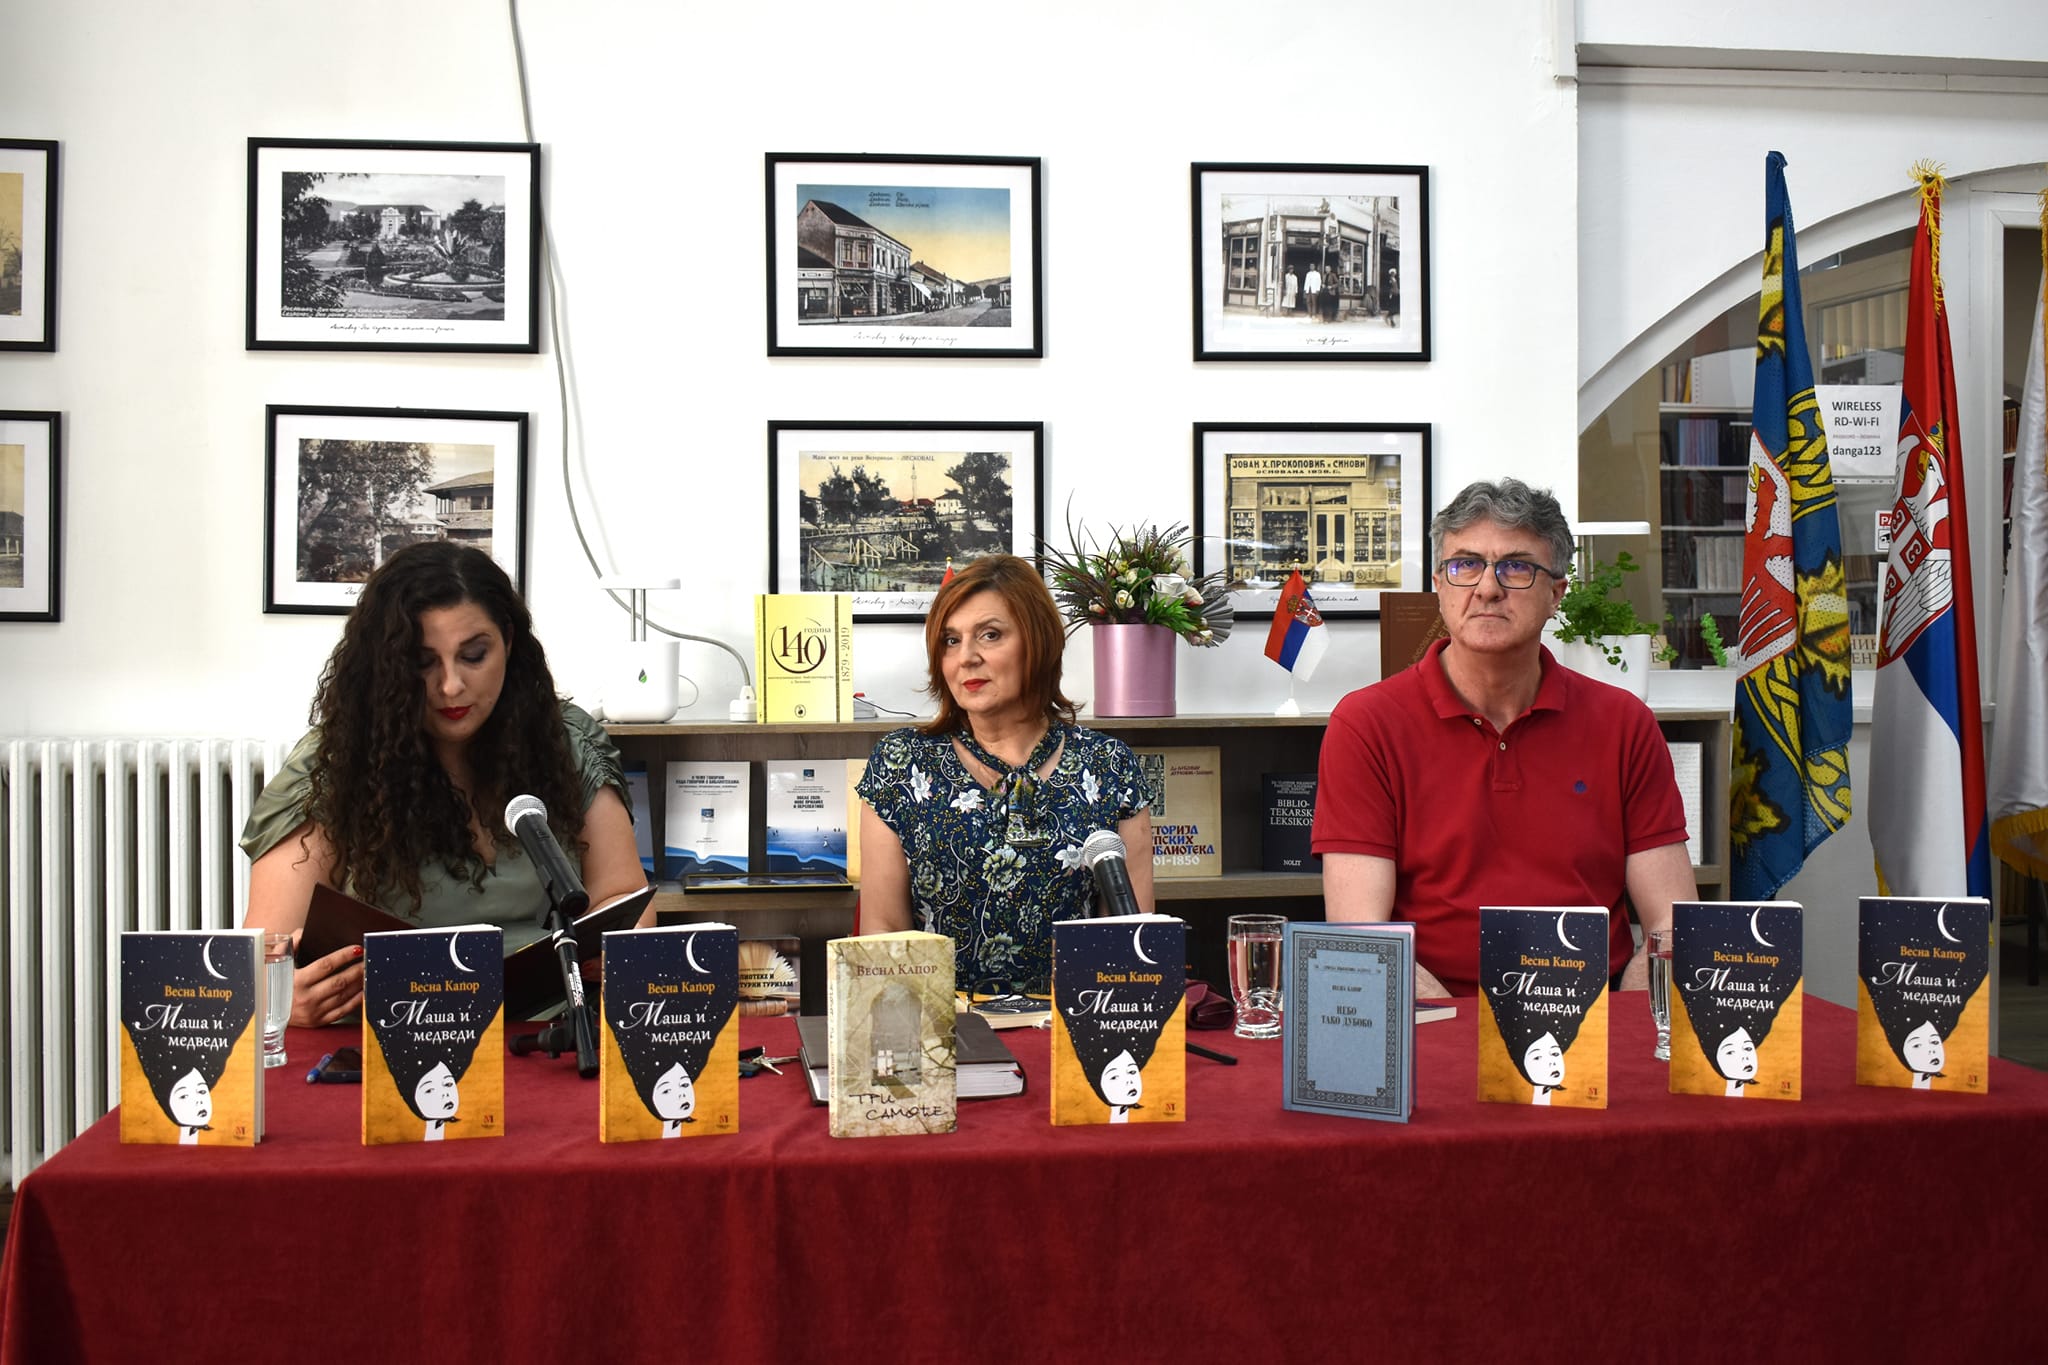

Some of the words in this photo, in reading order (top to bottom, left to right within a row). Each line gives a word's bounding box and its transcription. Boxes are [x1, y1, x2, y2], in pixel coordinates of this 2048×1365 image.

[1832, 402, 1881, 411] WIRELESS
[1834, 417, 1879, 426] RD-WI-FI
[1833, 446, 1881, 457] danga123
[1233, 460, 1259, 468] ЈОВАН
[1333, 460, 1365, 468] СИНОВИ
[779, 625, 825, 665] 140
[841, 627, 850, 651] 2019
[841, 660, 850, 682] 1879
[1277, 799, 1310, 807] BIBLIO-
[1270, 808, 1315, 817] TEKARSK
[1152, 835, 1194, 845] ПСКИХ
[1713, 951, 1743, 963] Весна
[1746, 952, 1779, 967] Капор
[1900, 945, 1930, 957] Весна
[1933, 947, 1966, 963] Капор
[1520, 954, 1550, 967] Весна
[1553, 956, 1585, 971] Капор
[1096, 971, 1126, 983] Весна
[1129, 970, 1163, 985] Капор
[1685, 966, 1755, 992] Маша
[1759, 982, 1769, 993] и
[1871, 961, 1941, 986] Маша
[1946, 977, 1956, 987] и
[410, 981, 442, 993] Весна
[445, 979, 480, 994] Капор
[648, 982, 679, 994] Весна
[682, 981, 715, 996] Капор
[1492, 971, 1562, 997] Маша
[1566, 986, 1576, 997] и
[164, 985, 196, 998] Весна
[199, 986, 233, 1001] Капор
[1903, 990, 1961, 1005] медведи
[1068, 988, 1139, 1016] Маша
[1143, 1002, 1153, 1013] и
[1523, 1001, 1582, 1016] медведи
[1716, 996, 1774, 1011] медведи
[134, 1003, 209, 1031] Маша
[213, 1018, 223, 1029] и
[379, 997, 456, 1028] Маша
[460, 1011, 470, 1023] и
[618, 999, 691, 1029] Маша
[696, 1013, 706, 1024] и
[1337, 1005, 1357, 1015] НЕБО
[1099, 1018, 1158, 1033] медведи
[1321, 1014, 1340, 1025] ТАКО
[1343, 1017, 1373, 1028] ДУБОКО
[168, 1036, 229, 1051] медведи
[413, 1029, 476, 1045] медведи
[651, 1029, 711, 1045] медведи
